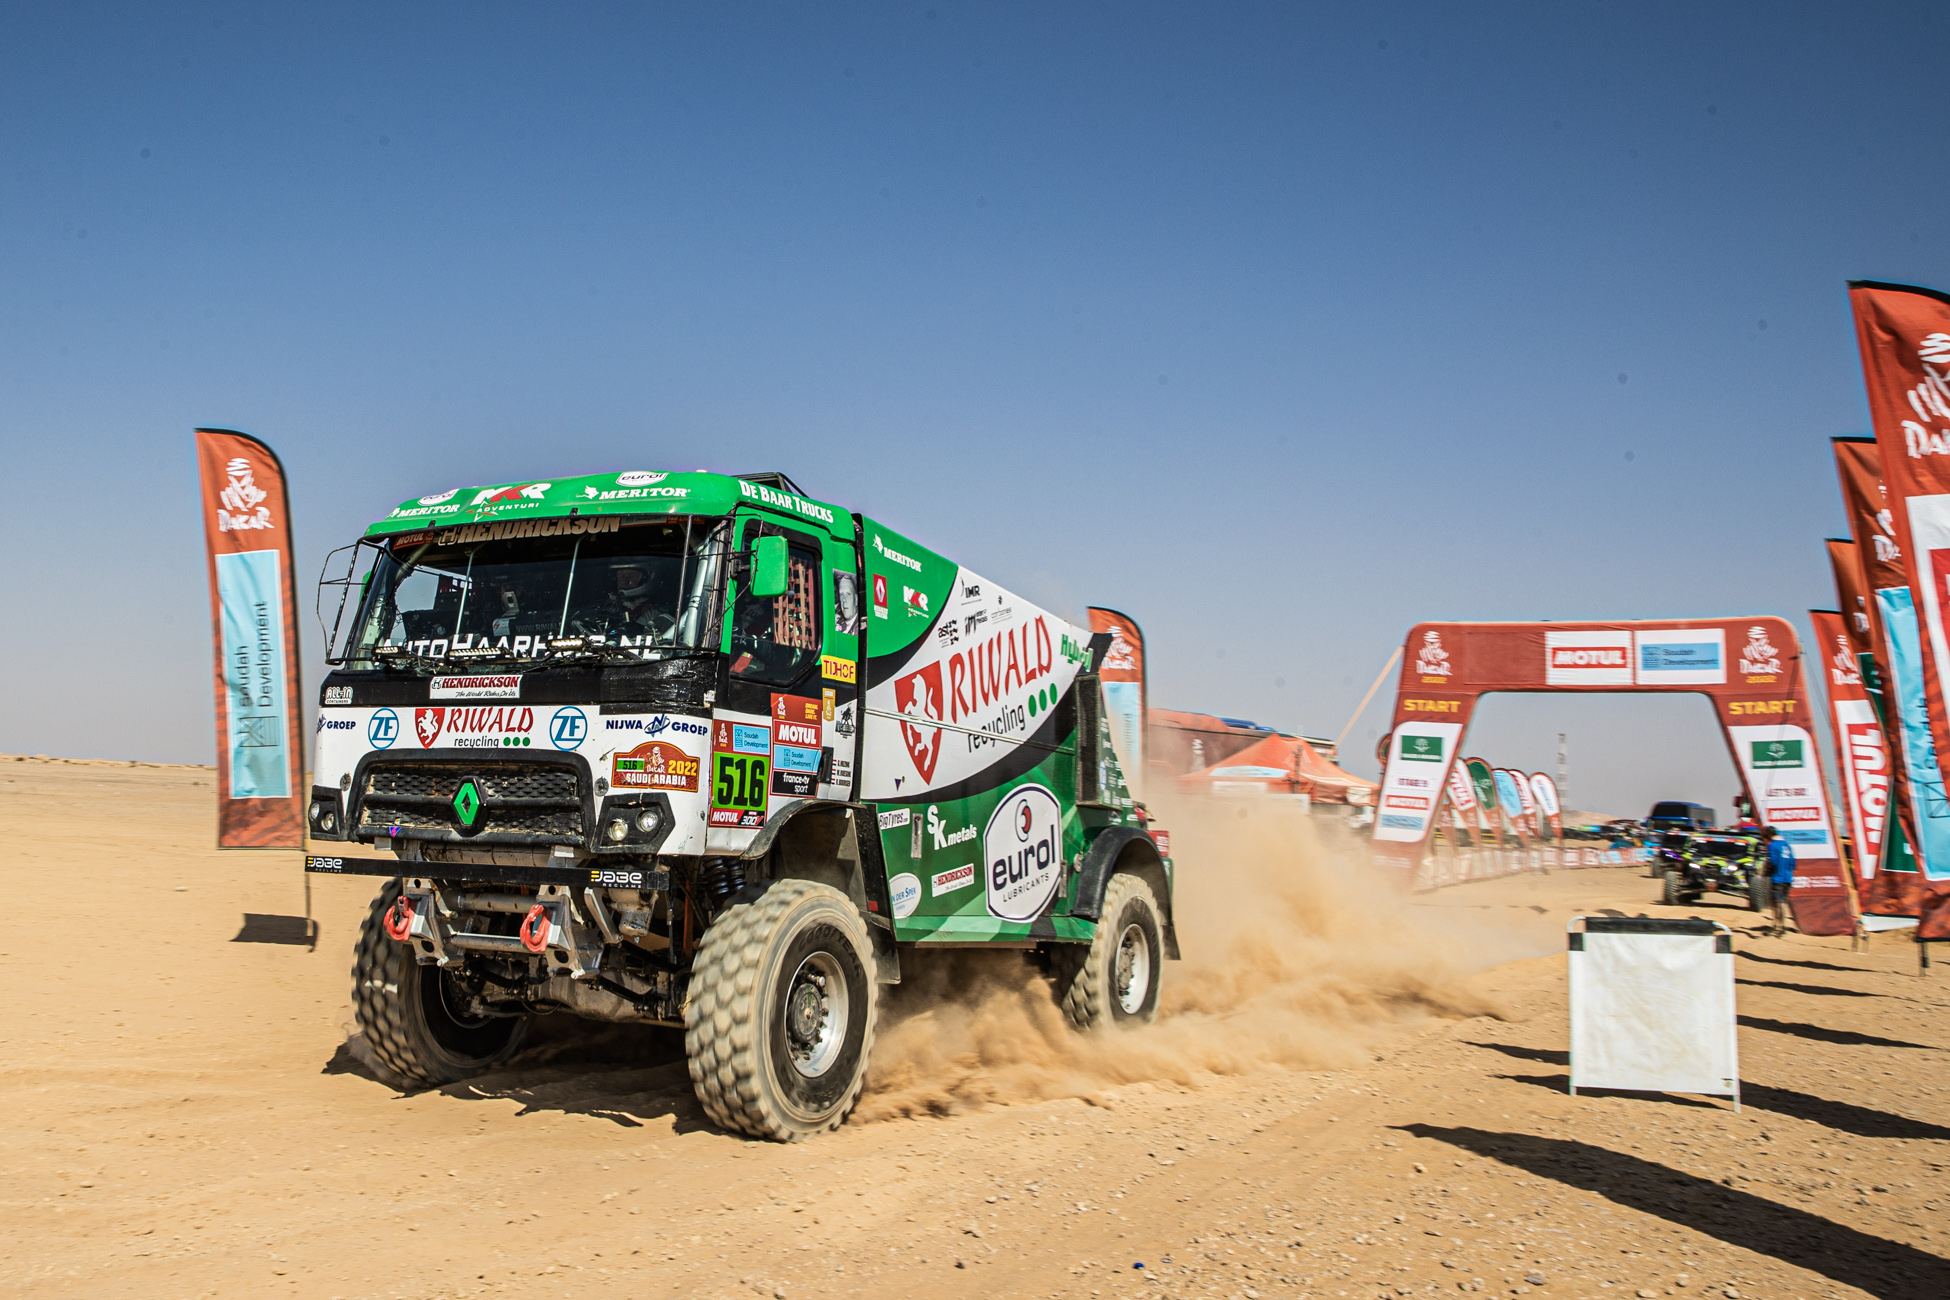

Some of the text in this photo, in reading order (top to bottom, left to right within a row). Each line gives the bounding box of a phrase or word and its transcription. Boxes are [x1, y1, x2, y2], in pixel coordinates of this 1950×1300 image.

[598, 487, 687, 500] MERITOR
[738, 480, 834, 523] DE BAAR TRUCKS
[397, 504, 460, 517] MERITOR
[884, 548, 922, 572] MERITOR
[1554, 650, 1624, 665] MOTUL
[948, 615, 1052, 724] RIWALD
[442, 676, 520, 688] HENDRICKSON
[1404, 699, 1461, 712] START
[1728, 700, 1797, 715] START
[326, 720, 356, 730] GROEP
[446, 706, 534, 733] RIWALD
[371, 716, 398, 741] ZF
[554, 716, 586, 742] ZF
[606, 720, 708, 736] NIJWA GROEP
[778, 724, 817, 744] MOTUL
[966, 704, 1026, 753] recycling
[454, 736, 499, 748] recycling
[744, 732, 758, 740] Soudah
[744, 740, 768, 748] Development
[622, 760, 638, 770] 516
[668, 760, 698, 776] 2022
[626, 774, 687, 786] SAUDI ARABIA
[718, 756, 765, 808] 516
[794, 784, 808, 794] sport
[712, 812, 738, 822] MOTUL
[948, 824, 978, 846] metals
[992, 824, 1056, 891] eurol
[1002, 873, 1049, 902] LUBRICANTS
